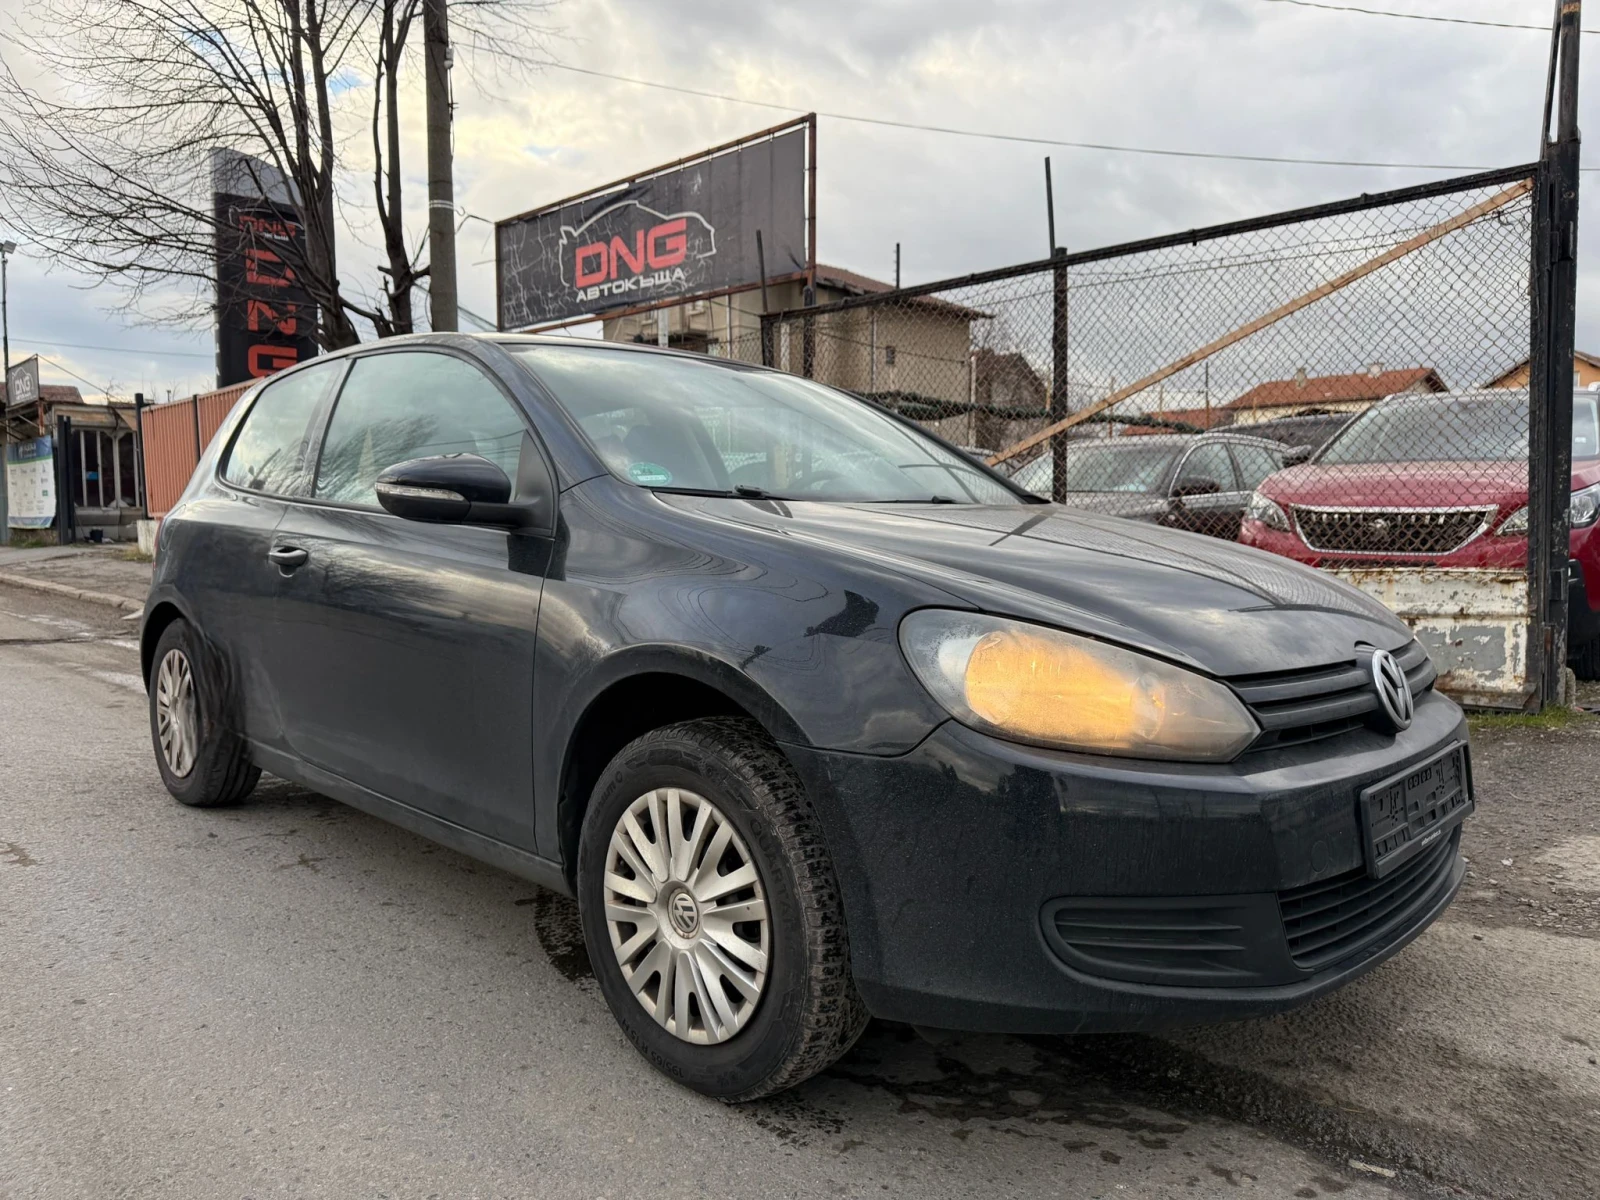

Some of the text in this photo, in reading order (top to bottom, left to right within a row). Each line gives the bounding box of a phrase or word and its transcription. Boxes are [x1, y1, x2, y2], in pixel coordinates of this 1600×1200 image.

[575, 218, 687, 289] DNG
[245, 248, 298, 378] DNG
[15, 376, 31, 395] DNG
[650, 1050, 684, 1079] 195/65
